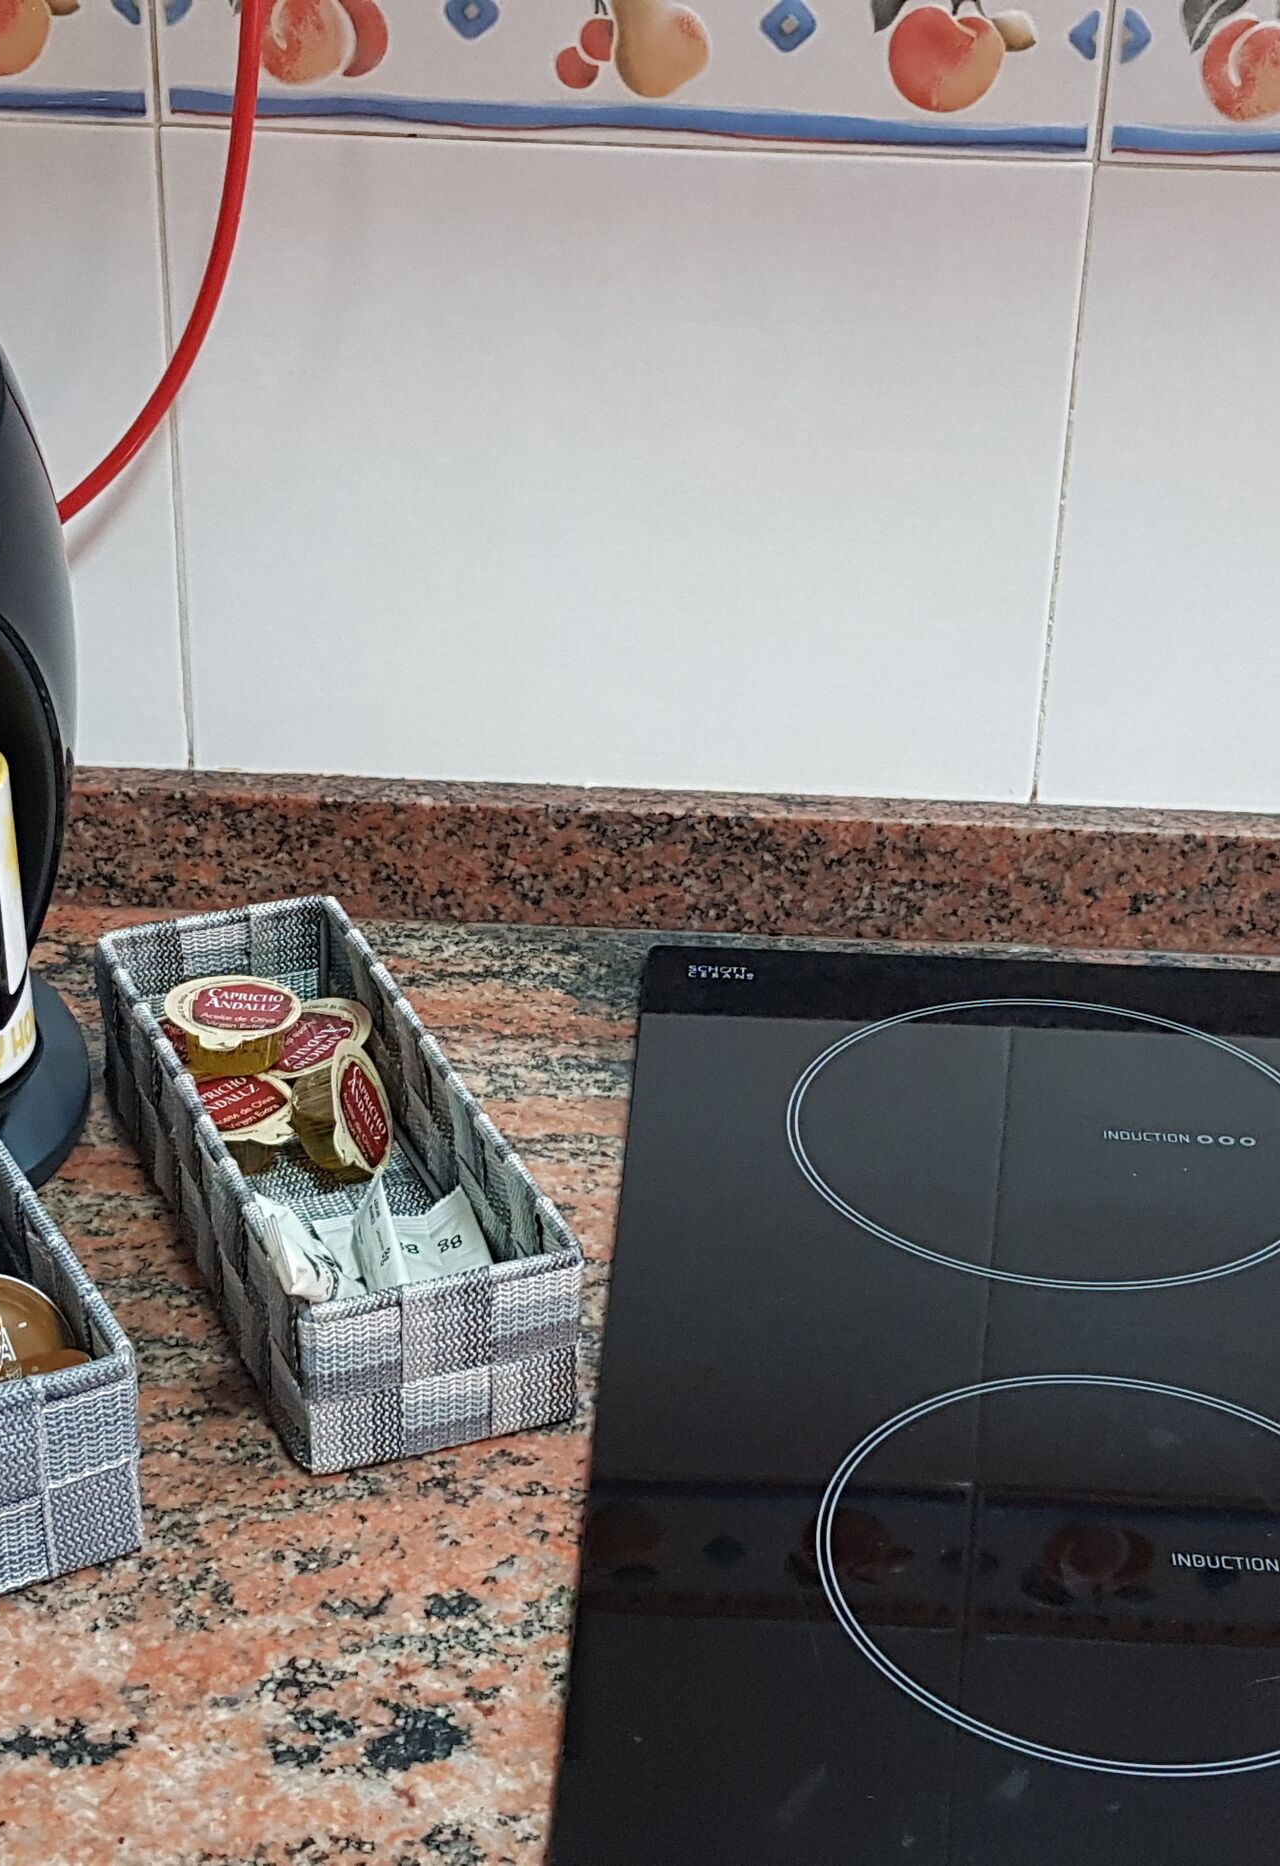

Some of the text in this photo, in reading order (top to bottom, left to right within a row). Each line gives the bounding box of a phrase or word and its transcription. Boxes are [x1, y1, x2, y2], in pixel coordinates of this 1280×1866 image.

[687, 964, 748, 974] SCHOTT
[208, 988, 285, 1003] CAPRICHO
[205, 997, 282, 1012] ANDALUZ
[200, 1077, 247, 1102] PRICHO
[204, 1083, 260, 1112] NDALUZ
[1102, 1129, 1192, 1144] INDUCTION
[1170, 1551, 1280, 1573] INDUCTION
